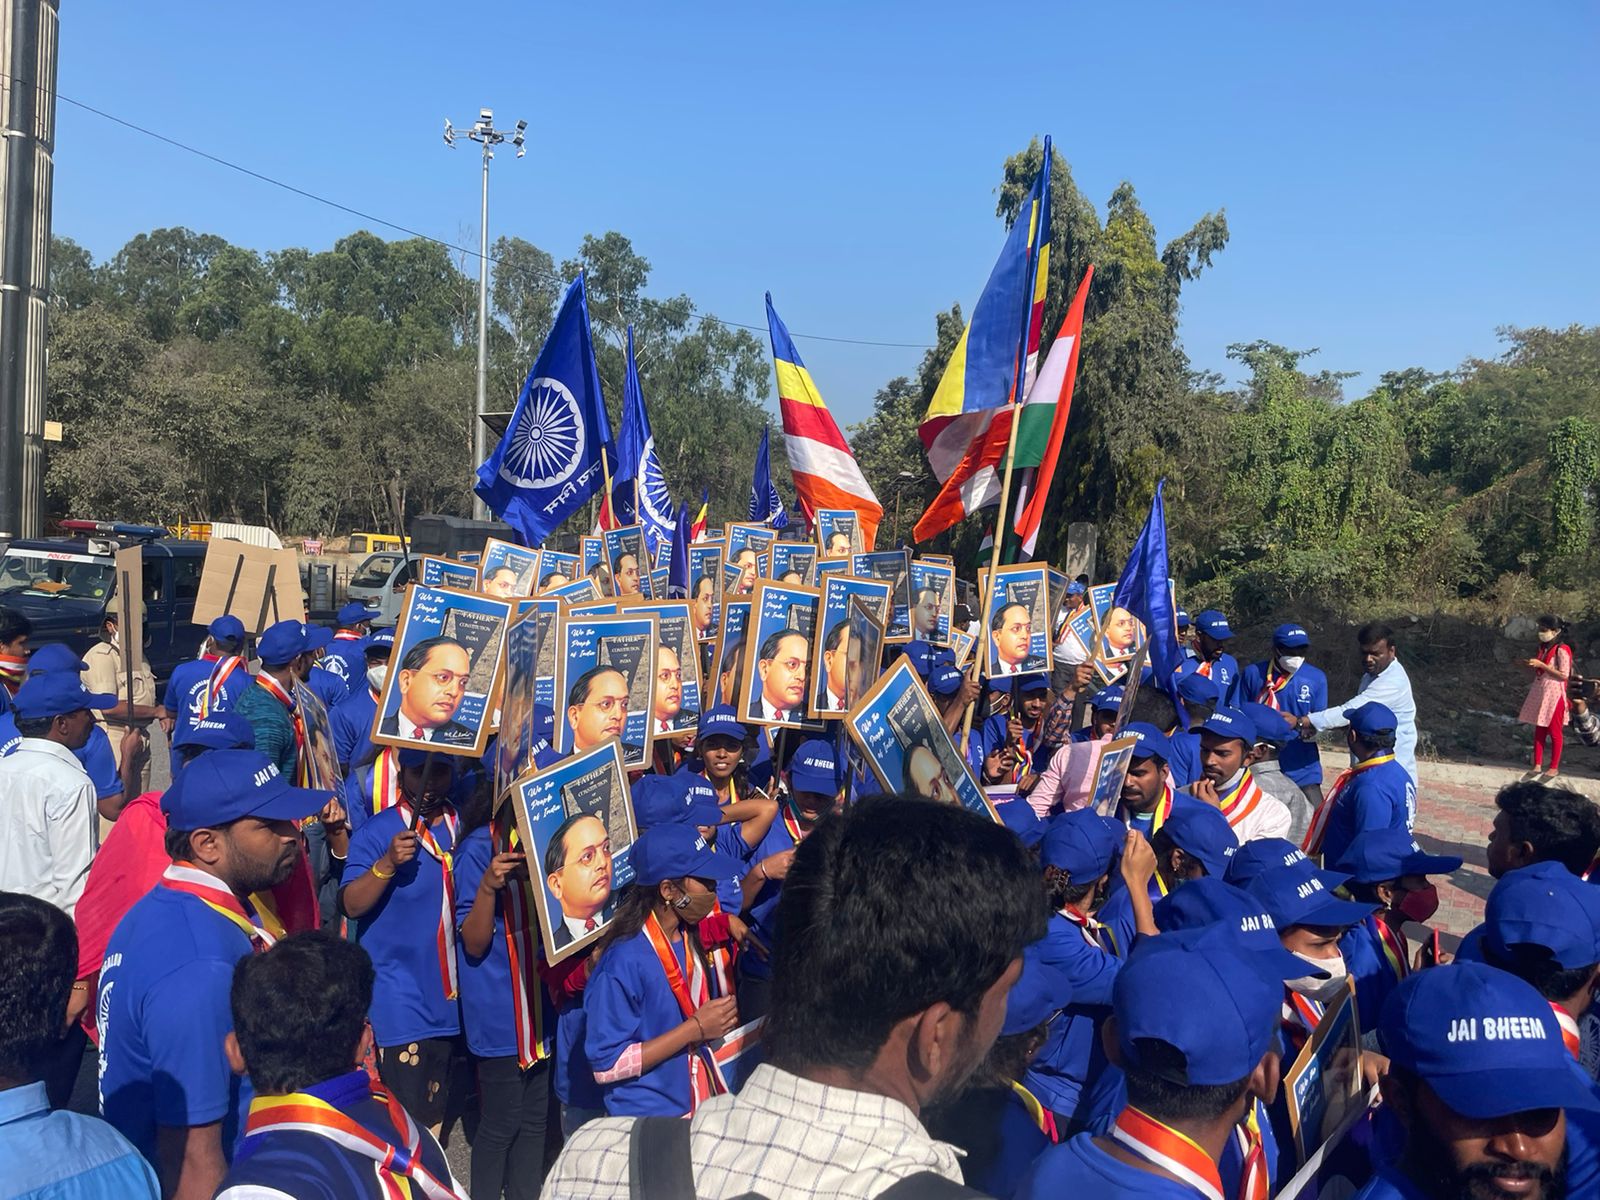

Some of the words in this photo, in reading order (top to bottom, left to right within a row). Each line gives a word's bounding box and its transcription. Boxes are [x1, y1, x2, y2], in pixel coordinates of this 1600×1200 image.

[47, 552, 72, 560] POLICE
[418, 592, 432, 601] We
[415, 603, 438, 614] People
[422, 614, 441, 625] India
[462, 611, 492, 622] FATHER
[570, 640, 591, 648] People
[578, 650, 596, 658] India
[716, 714, 736, 723] BHEEM
[803, 757, 813, 766] JAI
[813, 758, 835, 770] BHEEM
[253, 768, 271, 787] JAI
[576, 767, 605, 787] FATHER
[527, 786, 542, 798] We
[544, 780, 555, 791] the
[530, 794, 553, 811] People
[532, 813, 541, 822] of
[542, 804, 561, 818] India
[1283, 852, 1298, 867] JAI
[1296, 884, 1312, 899] JAI
[1240, 916, 1261, 932] JAI
[1447, 1017, 1477, 1043] JAI
[1482, 1016, 1547, 1041] BHEEM
